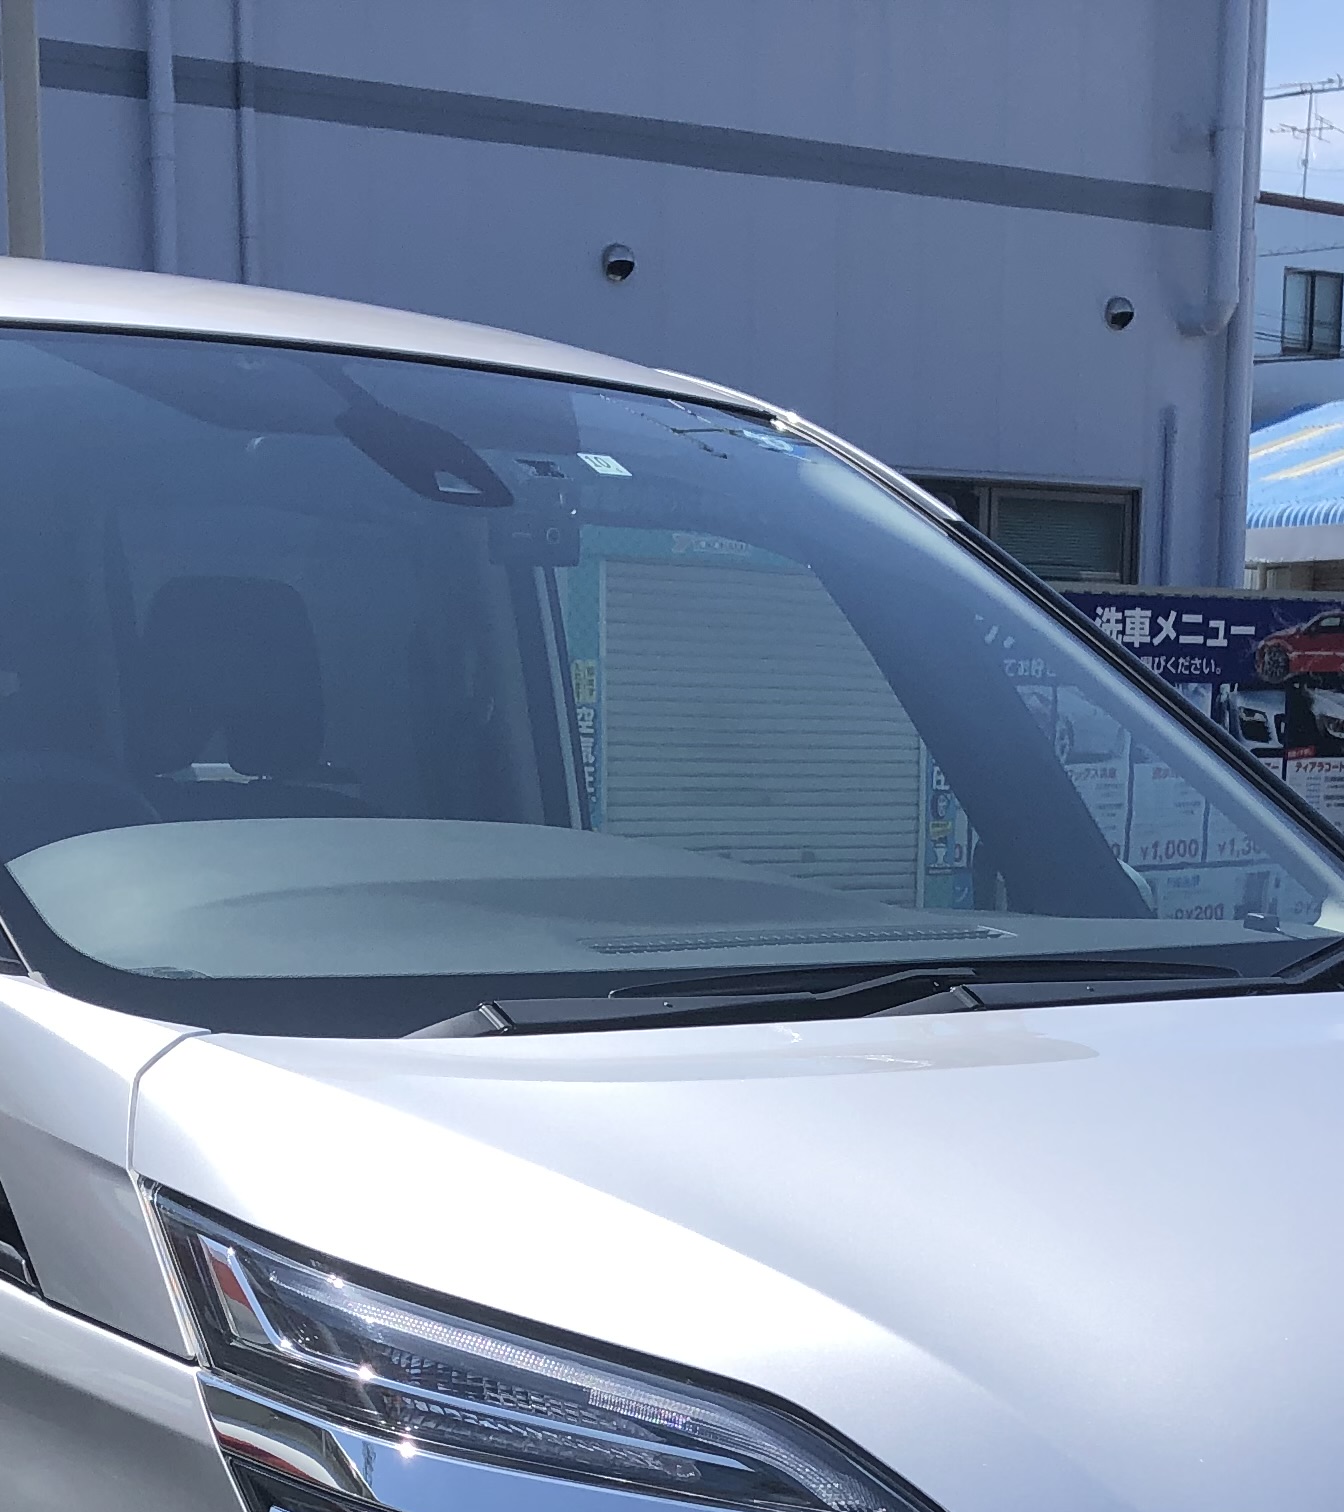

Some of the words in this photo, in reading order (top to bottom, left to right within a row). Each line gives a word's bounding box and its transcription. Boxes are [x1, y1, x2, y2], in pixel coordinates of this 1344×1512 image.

[1094, 606, 1256, 647] 洗車メニュー
